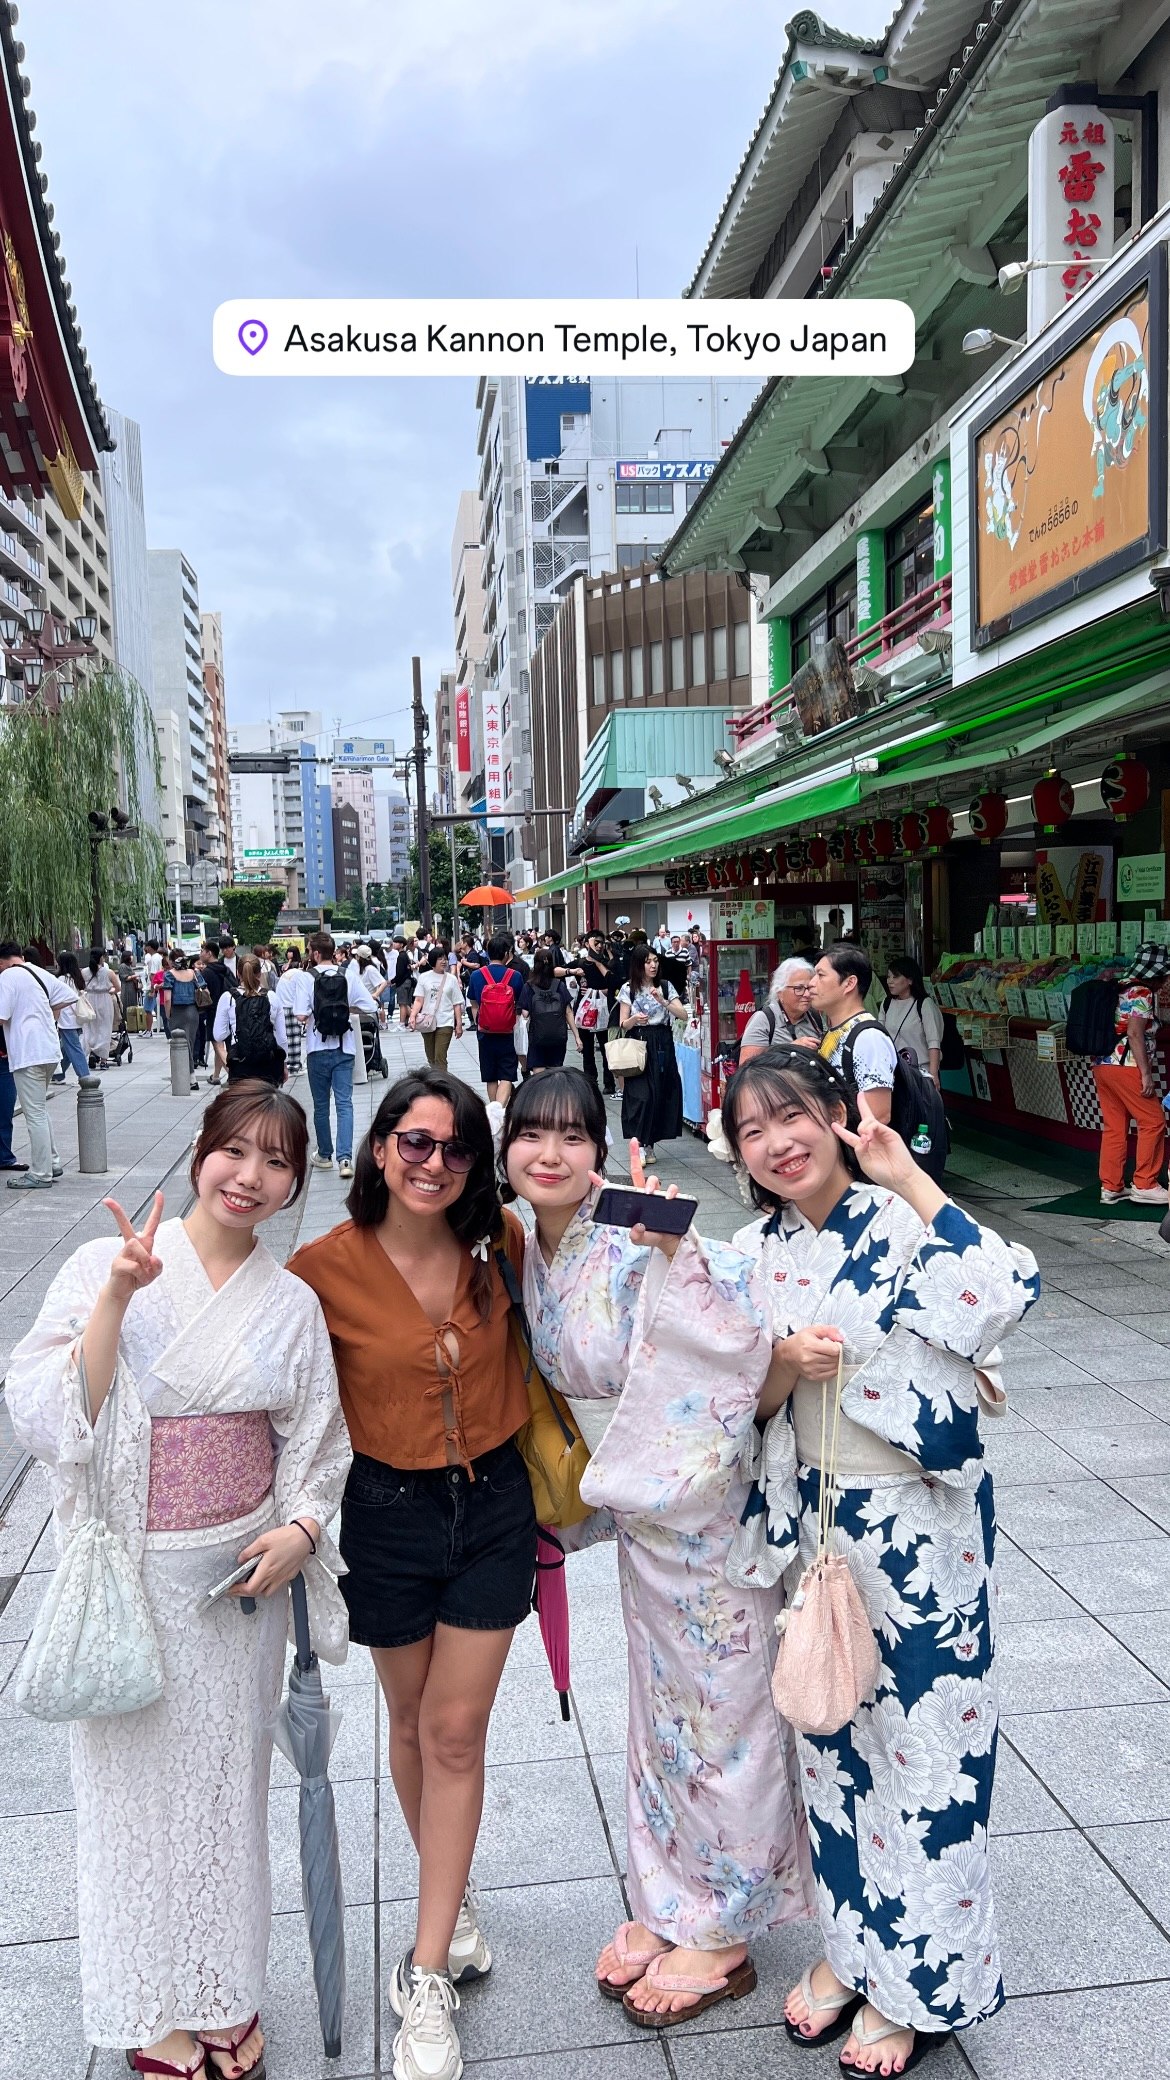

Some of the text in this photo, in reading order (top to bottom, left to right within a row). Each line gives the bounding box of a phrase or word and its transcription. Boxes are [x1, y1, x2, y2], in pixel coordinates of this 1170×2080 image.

[1059, 122, 1106, 145] 元祖
[459, 701, 468, 737] 北陸銀行
[486, 704, 501, 814] 大東京信用組合
